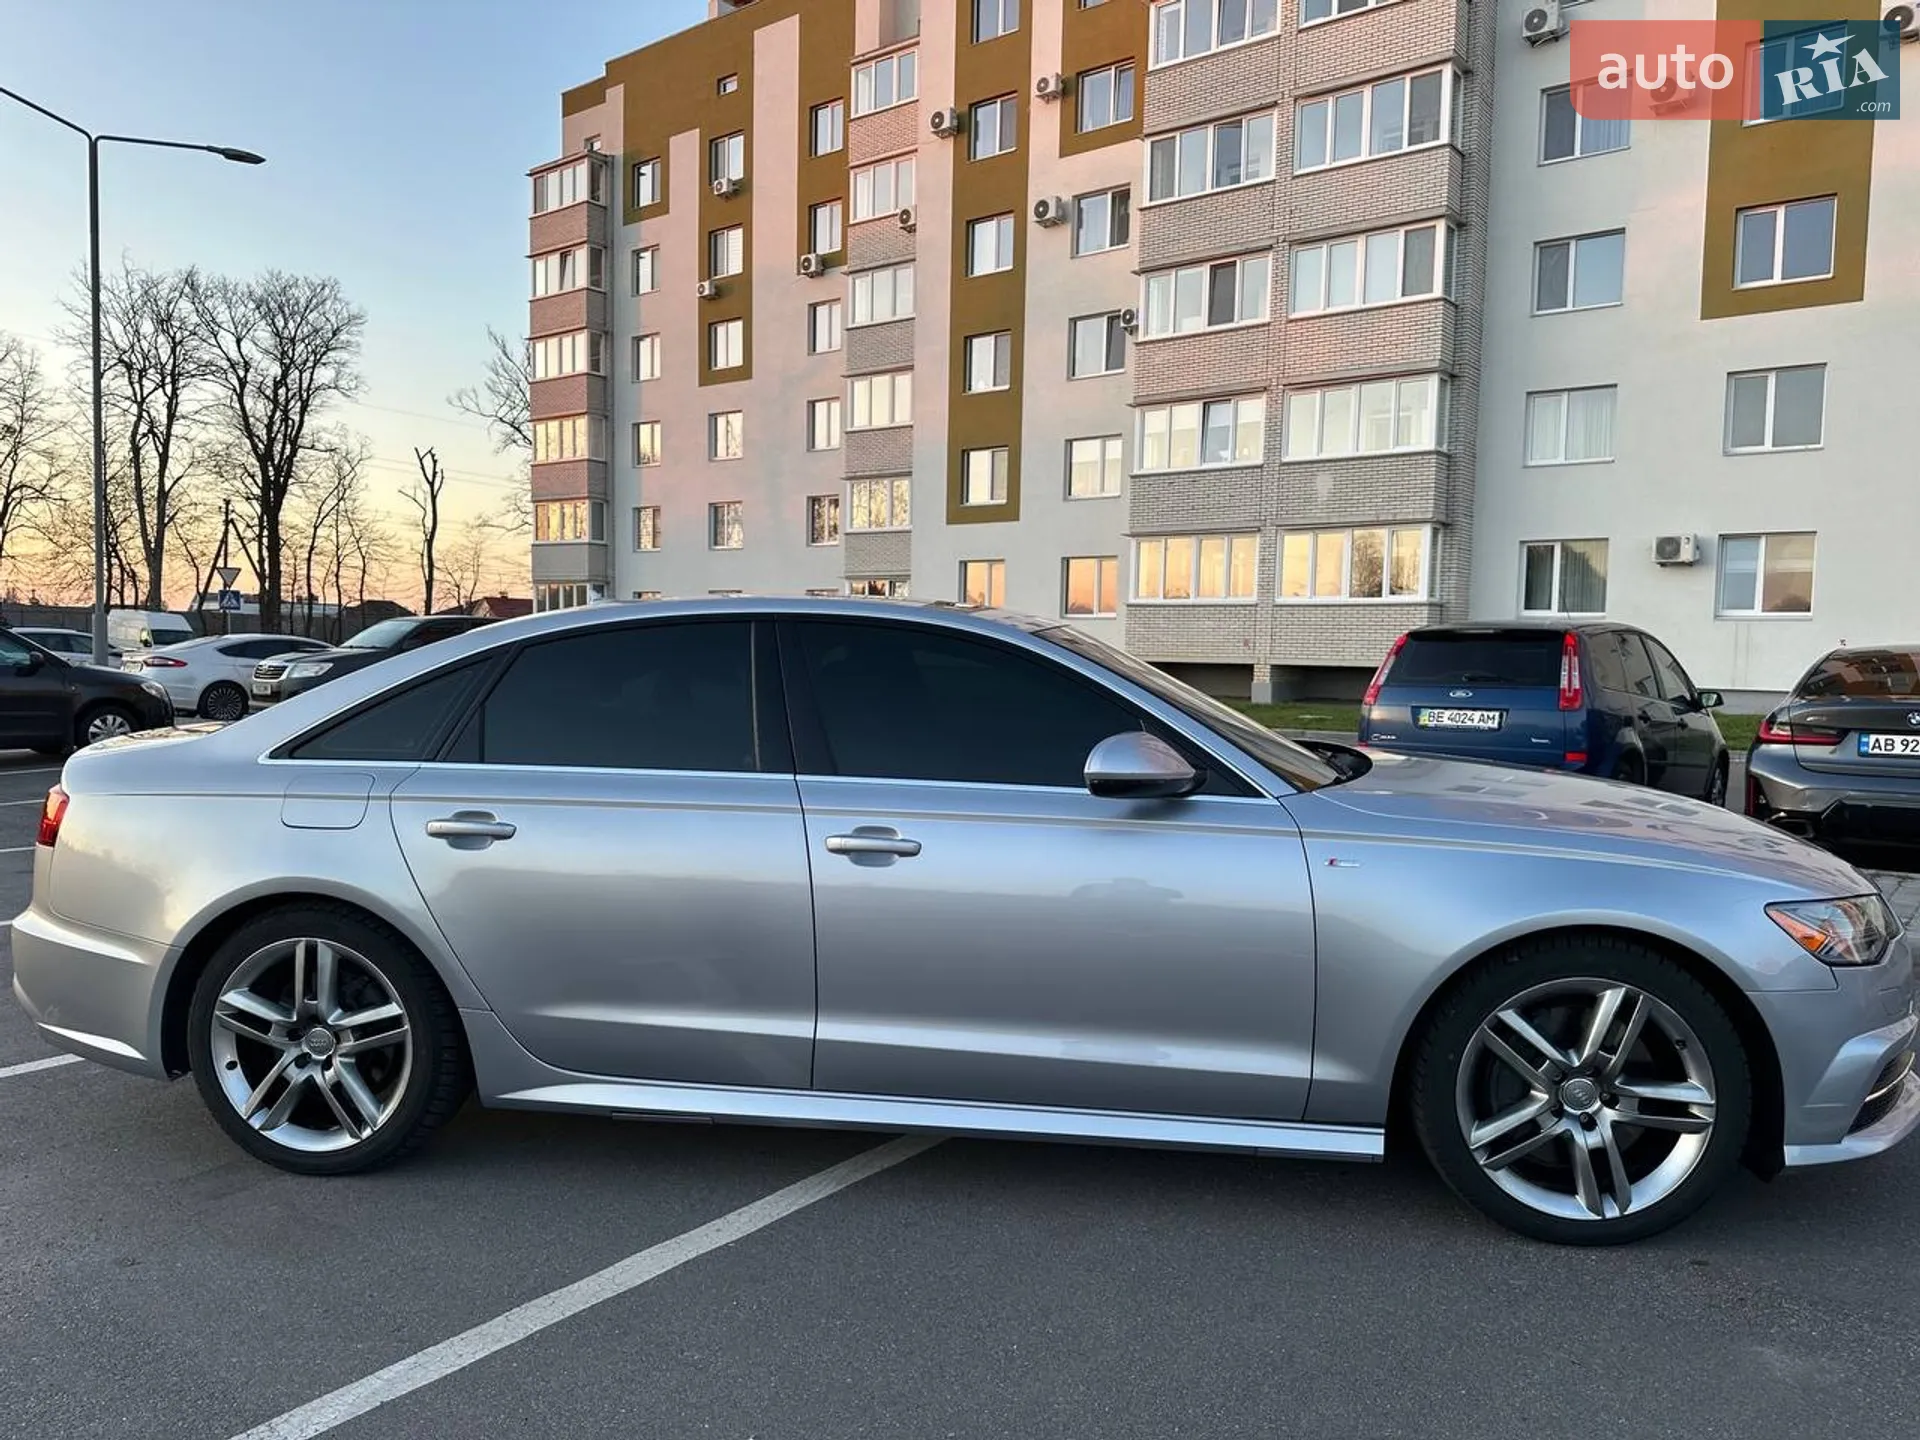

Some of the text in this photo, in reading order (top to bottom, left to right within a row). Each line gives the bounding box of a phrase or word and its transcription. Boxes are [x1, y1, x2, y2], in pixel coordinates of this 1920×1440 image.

[1428, 711, 1496, 725] BE 4024 AM
[1870, 738, 1896, 752] AB
